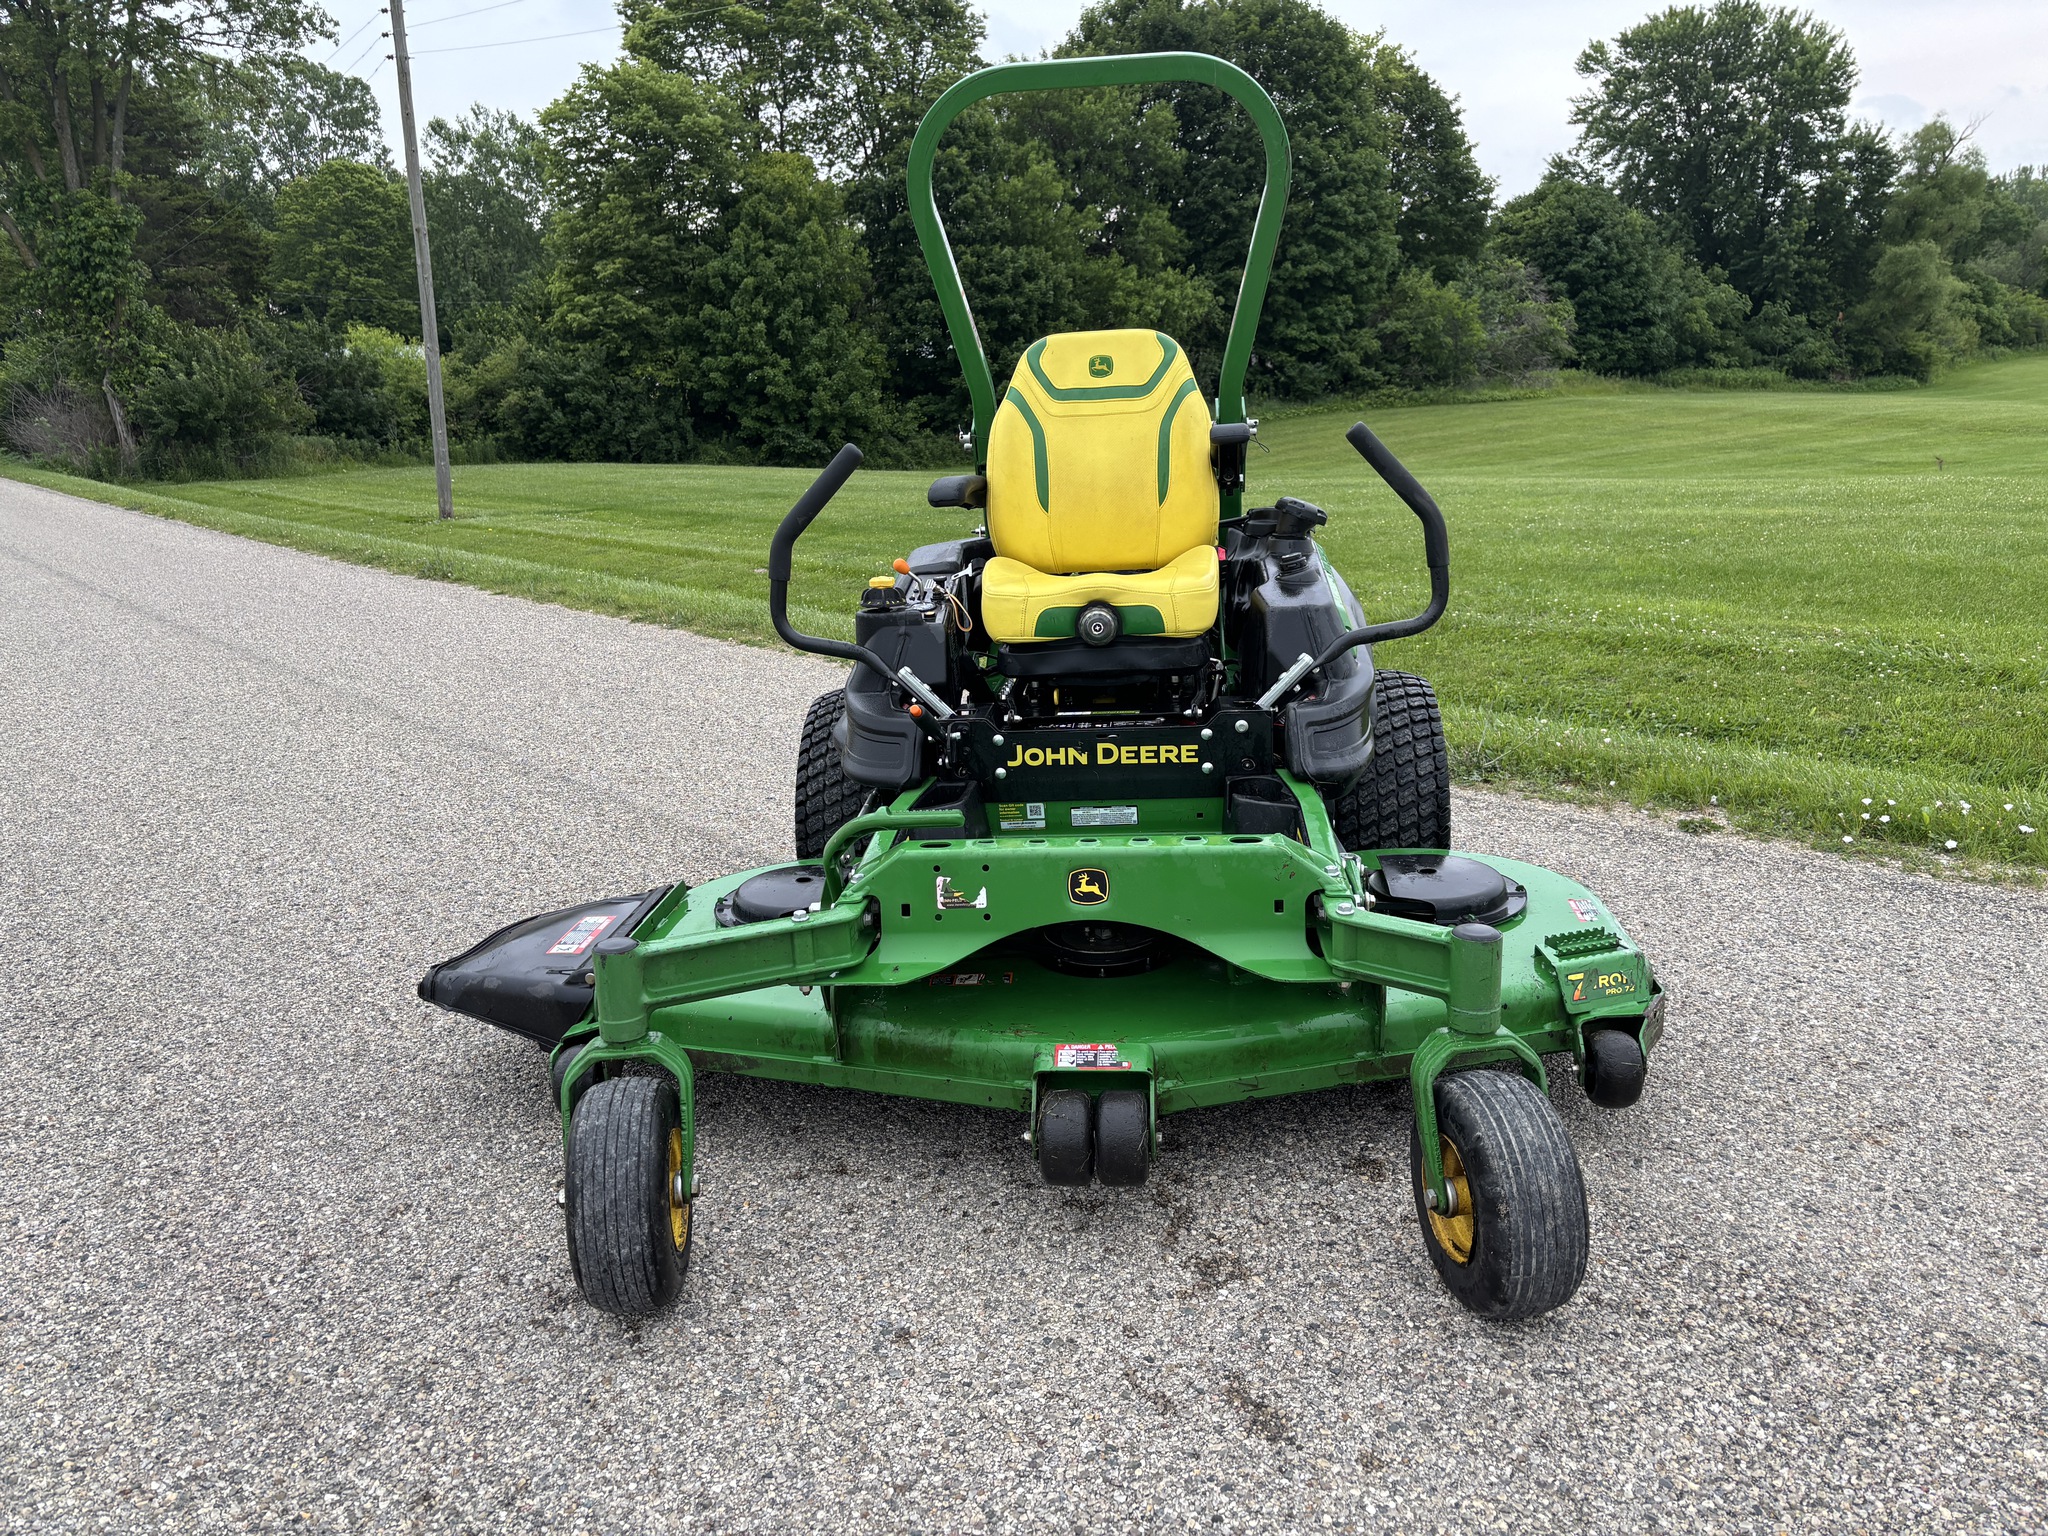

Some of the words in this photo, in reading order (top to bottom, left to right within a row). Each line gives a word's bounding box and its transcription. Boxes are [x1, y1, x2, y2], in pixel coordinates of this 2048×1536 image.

[1007, 745, 1088, 767] JOHN
[1096, 743, 1199, 764] DEERE
[1605, 987, 1622, 995] PRO
